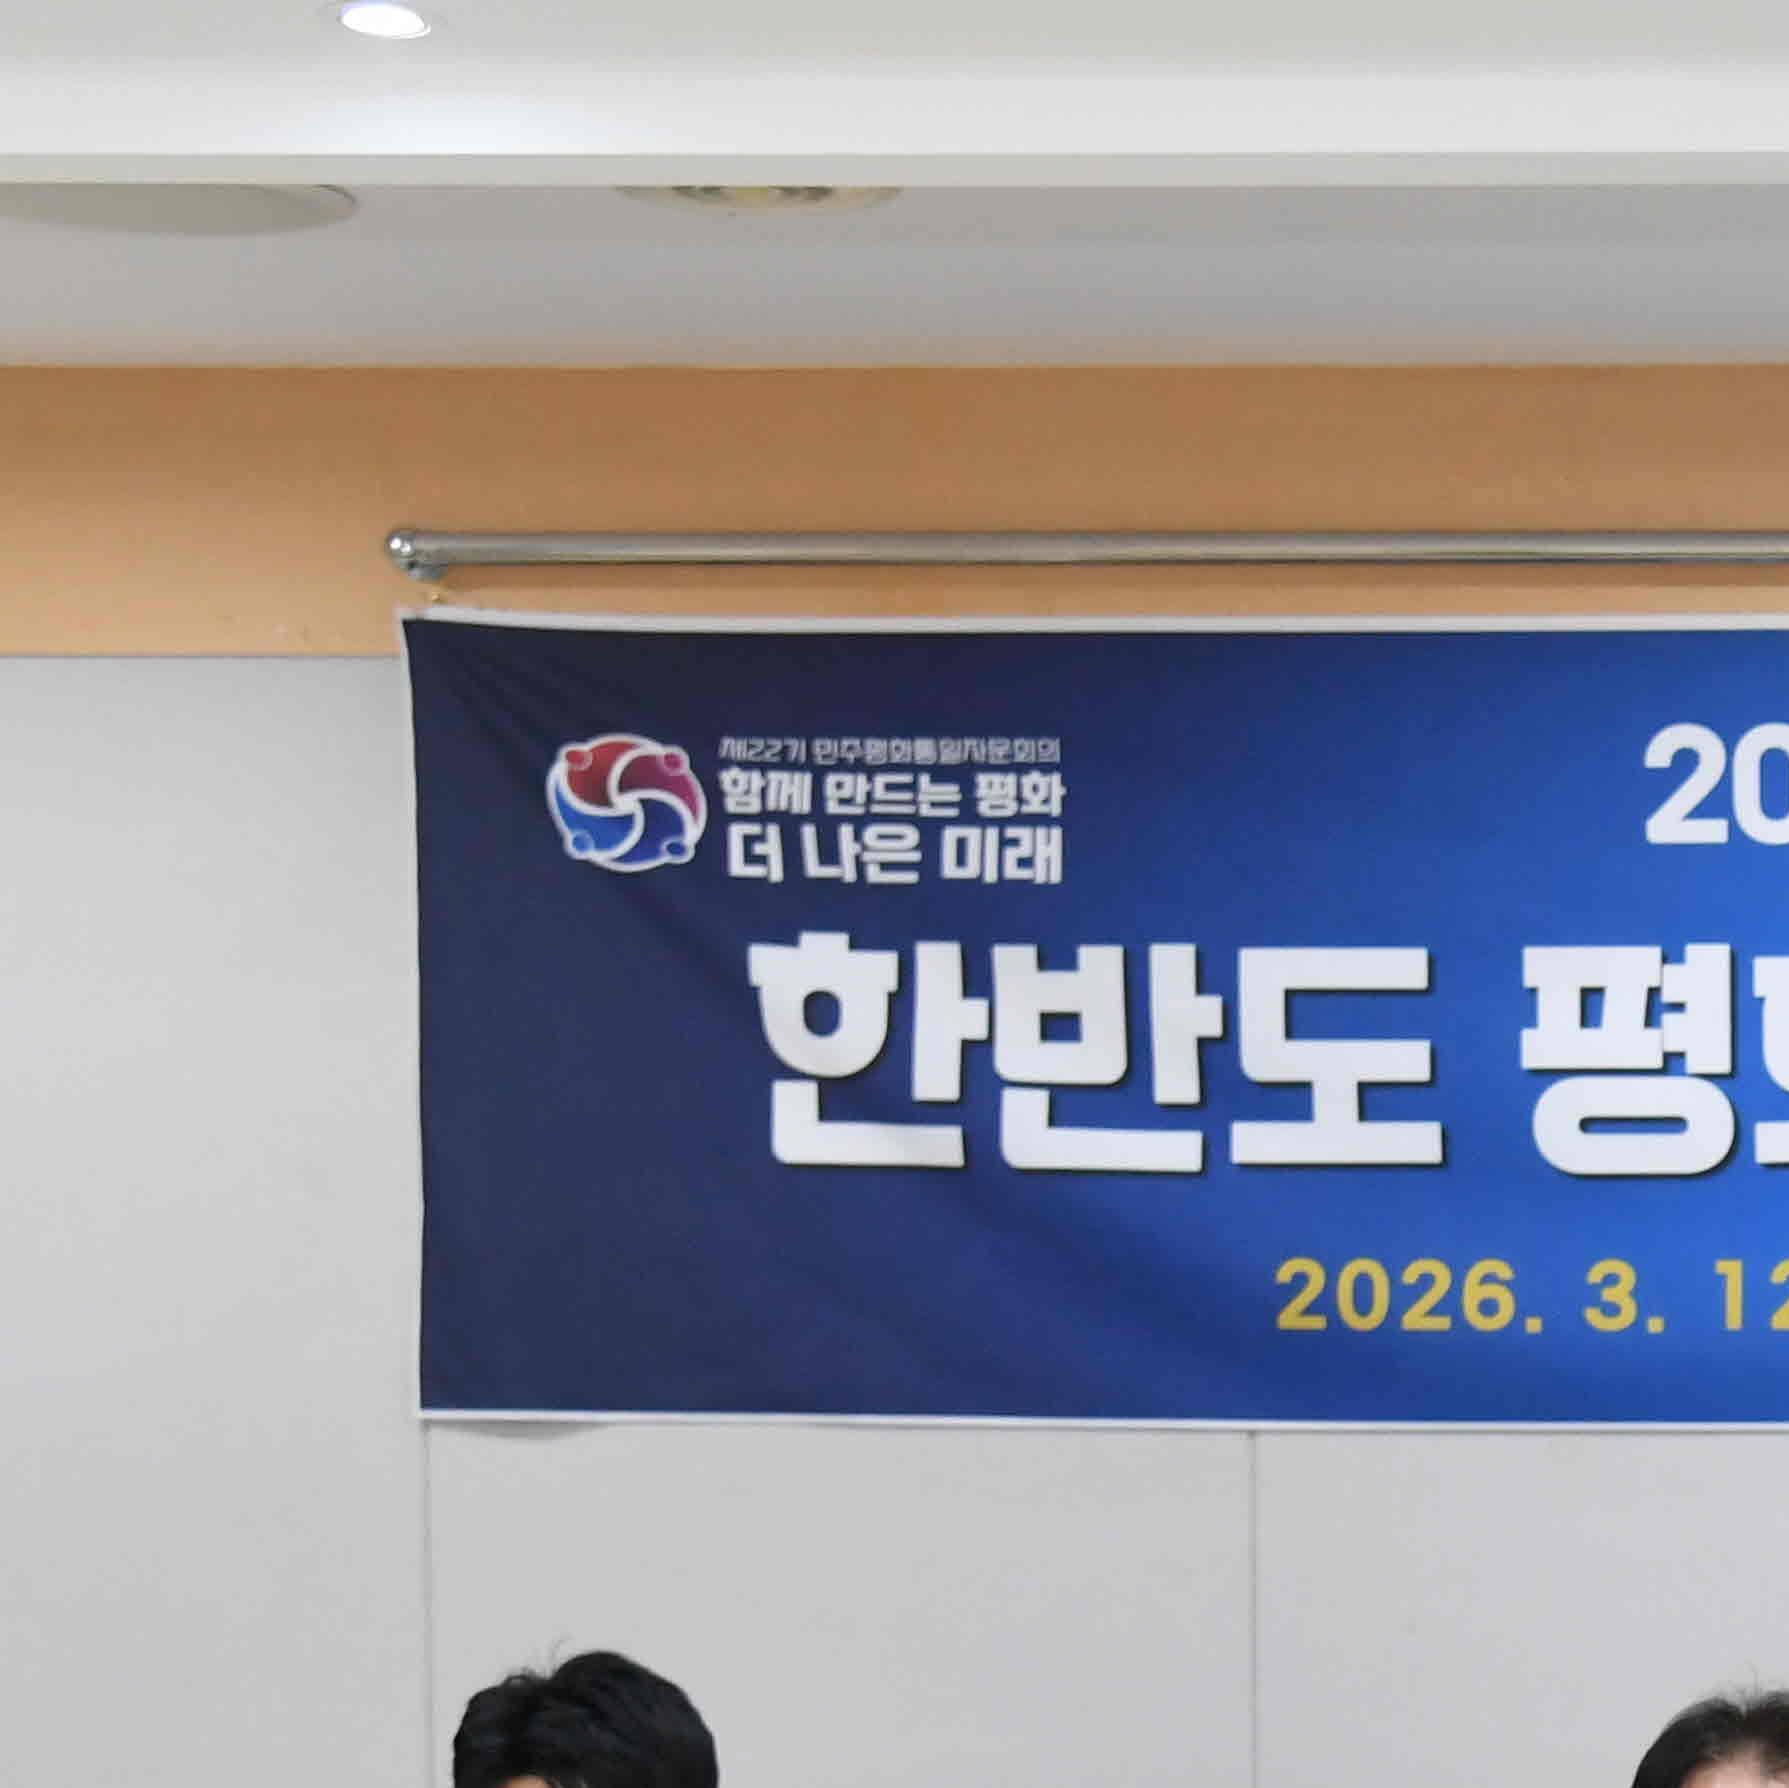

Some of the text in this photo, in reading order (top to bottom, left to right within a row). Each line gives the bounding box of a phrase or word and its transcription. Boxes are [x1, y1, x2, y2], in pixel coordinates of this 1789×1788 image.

[718, 737, 1062, 765] 제22기 민주평화통일자문회의
[719, 767, 1066, 817] 함께 만드는 평화
[728, 822, 1062, 884] 더 나은 미래
[748, 932, 1442, 1172] 한반도
[1275, 1256, 1542, 1334] 2026.
[1584, 1258, 1665, 1333] 3.
